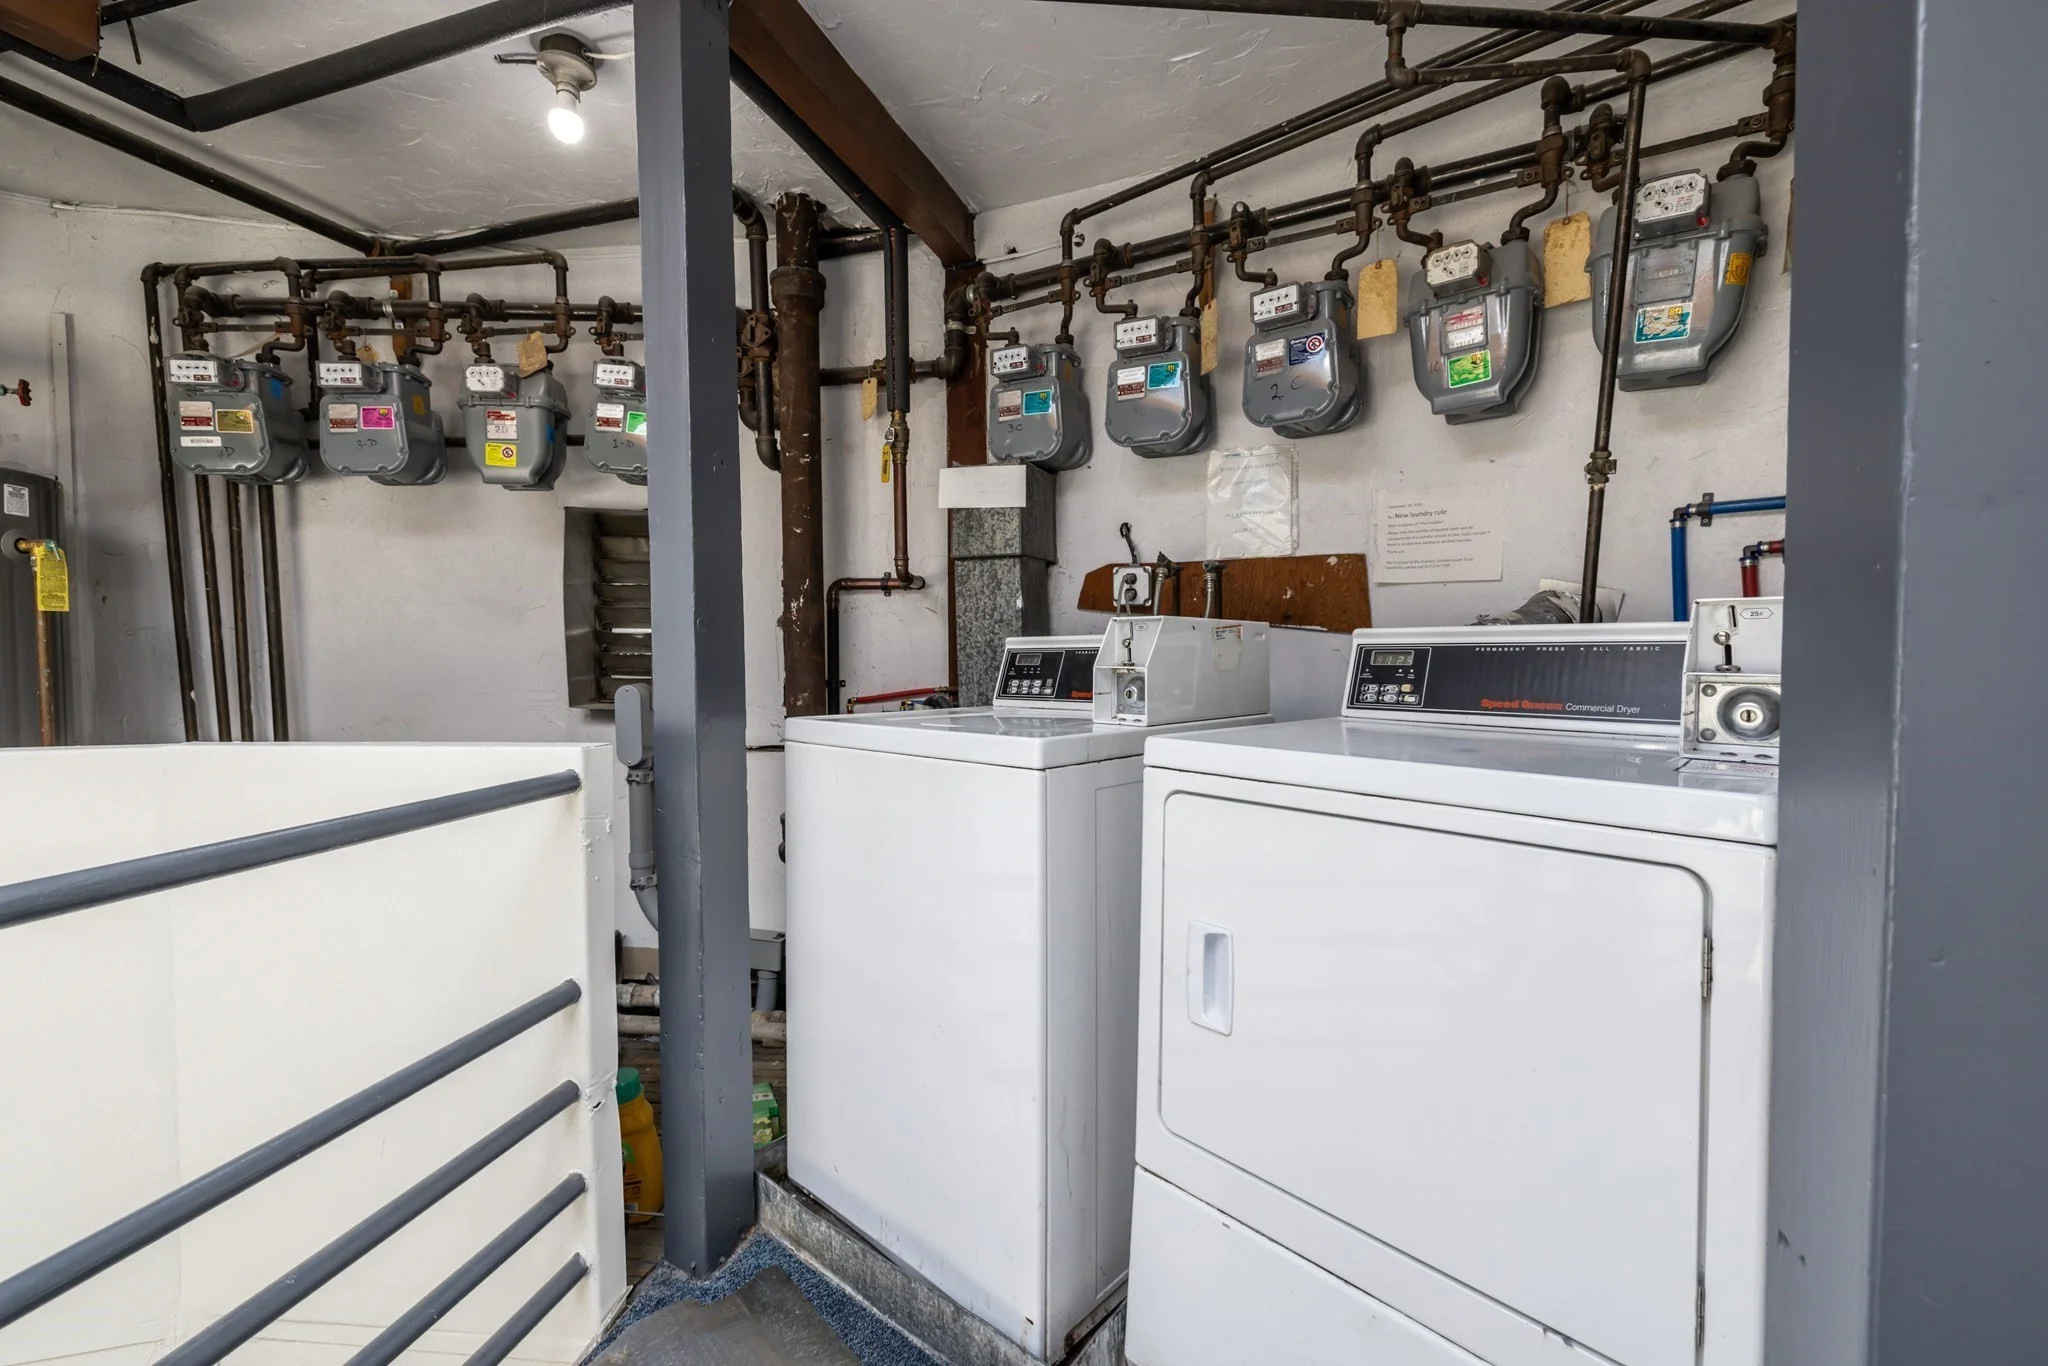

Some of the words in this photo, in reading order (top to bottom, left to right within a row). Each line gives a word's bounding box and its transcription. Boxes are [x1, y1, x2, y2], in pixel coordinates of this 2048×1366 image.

[1270, 383, 1287, 401] 2
[1409, 510, 1433, 518] laundry
[1480, 698, 1519, 709] Speed
[1520, 699, 1562, 711] Queen
[1565, 702, 1614, 713] Commercial
[1616, 704, 1641, 716] Dryer
